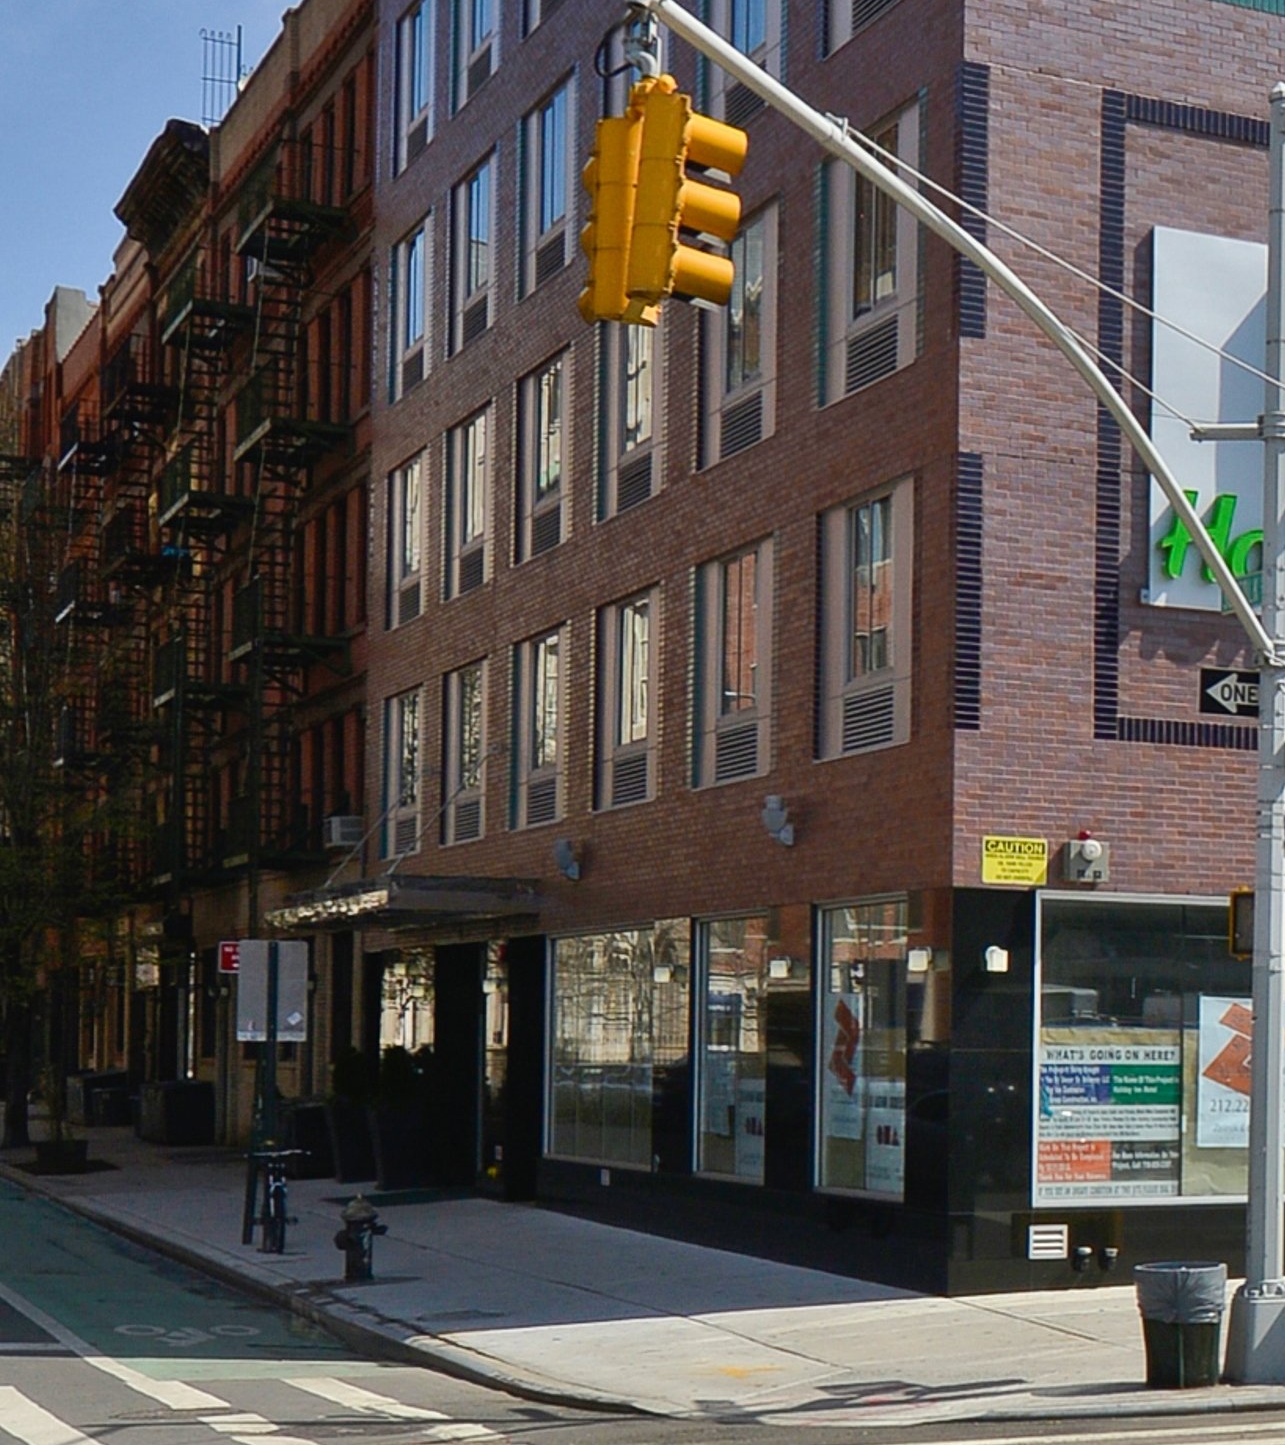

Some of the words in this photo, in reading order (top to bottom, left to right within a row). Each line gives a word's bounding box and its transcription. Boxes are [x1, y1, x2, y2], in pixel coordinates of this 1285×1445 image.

[1220, 682, 1260, 704] ONE
[986, 840, 1043, 854] CAUTION
[1046, 1049, 1084, 1061] WHAT'S
[1089, 1049, 1122, 1061] GOING
[1125, 1049, 1140, 1061] ON
[1143, 1049, 1175, 1061] HERE?
